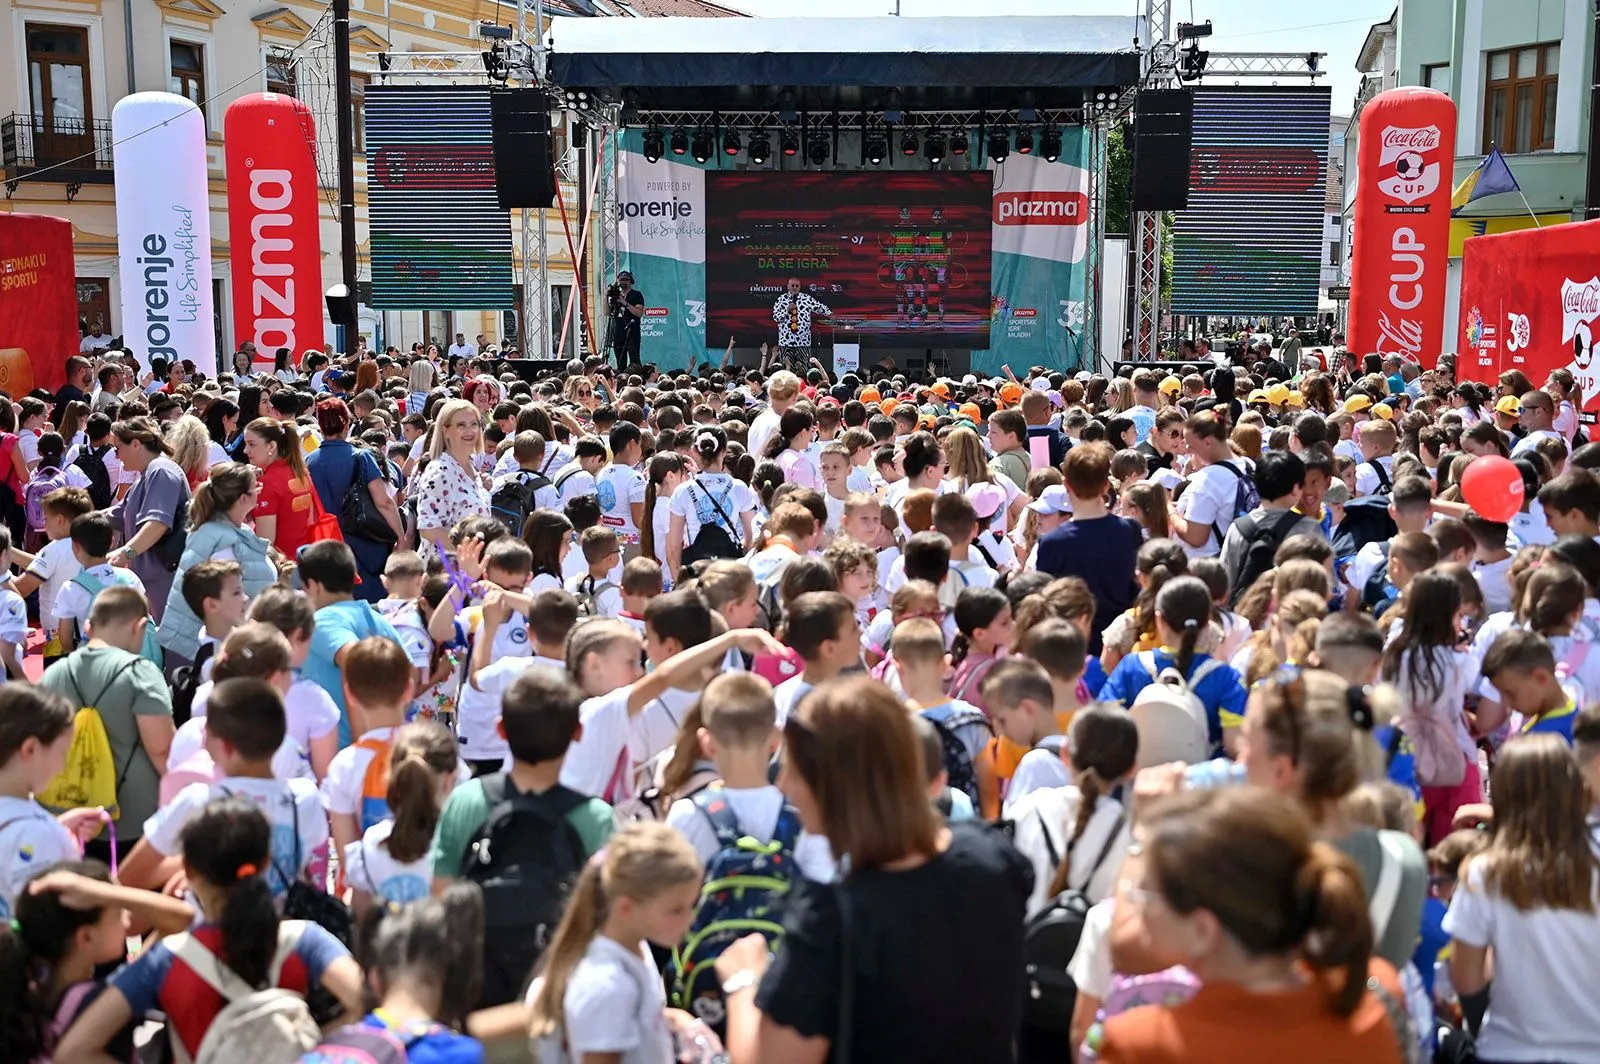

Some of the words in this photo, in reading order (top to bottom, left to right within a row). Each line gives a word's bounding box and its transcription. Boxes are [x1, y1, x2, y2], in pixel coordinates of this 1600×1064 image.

[1384, 129, 1438, 148] Coca-Cola
[682, 181, 692, 191] BY
[1392, 184, 1425, 194] CUP
[610, 196, 692, 221] gorenje
[998, 196, 1078, 222] plazma
[640, 220, 659, 239] Life
[171, 204, 200, 292] Simplified
[39, 252, 47, 266] U
[758, 257, 775, 269] DA
[778, 257, 794, 269] SE
[798, 257, 829, 269] IGRA
[1388, 226, 1425, 310] CUP
[2, 270, 39, 292] SPORTU
[136, 233, 178, 368] gorenje
[176, 293, 202, 323] Life
[1013, 309, 1035, 317] plazma
[1574, 375, 1594, 391] UP
